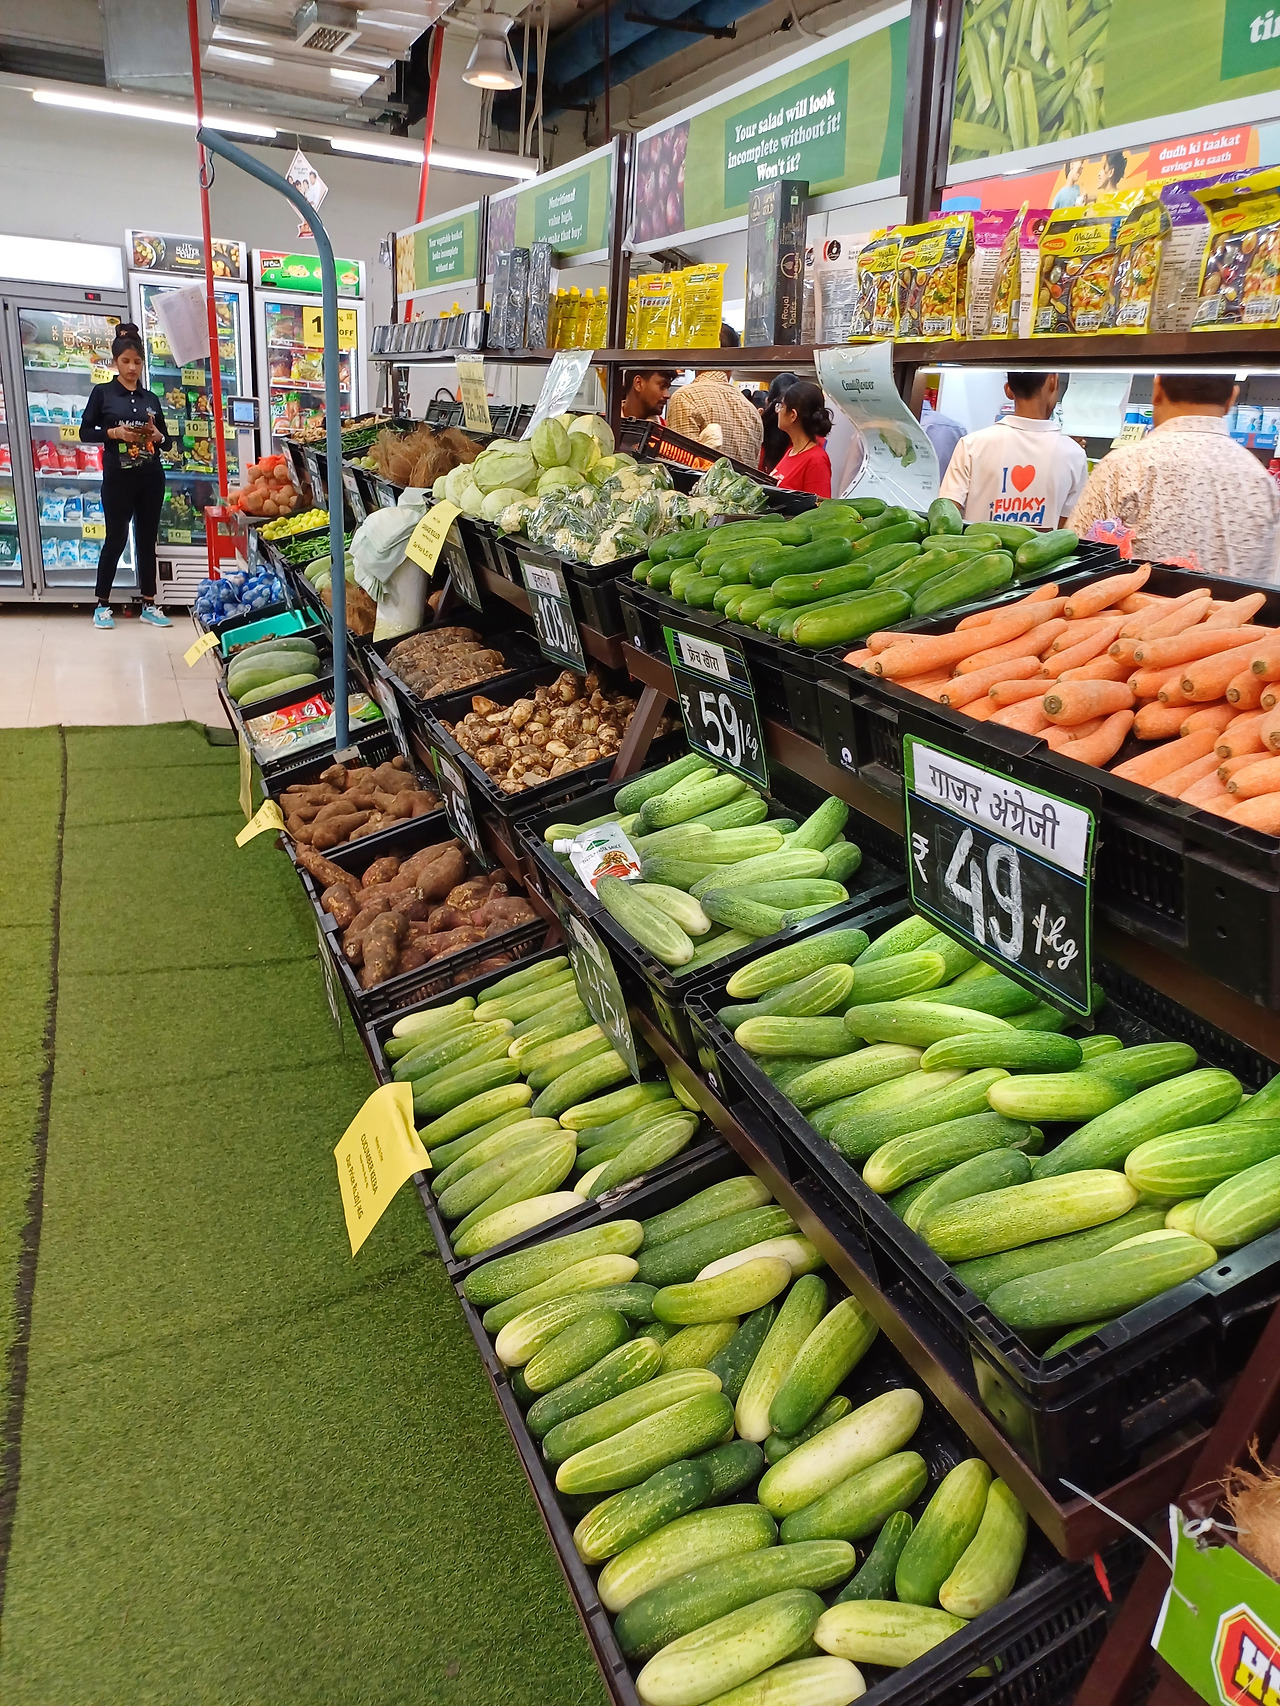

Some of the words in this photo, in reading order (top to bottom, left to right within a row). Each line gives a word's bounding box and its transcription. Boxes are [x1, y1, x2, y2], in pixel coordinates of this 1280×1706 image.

[1250, 9, 1280, 43] ti
[735, 123, 757, 143] Your
[758, 108, 784, 135] salad
[785, 97, 808, 123] will
[808, 87, 835, 114] look
[728, 138, 779, 169] incomplete
[780, 119, 826, 149] without
[826, 111, 841, 135] it!
[1159, 144, 1187, 161] dudh
[1188, 141, 1201, 155] ki
[1203, 133, 1241, 151] taakat
[756, 158, 785, 182] Won't
[786, 152, 801, 174] it?
[1161, 160, 1193, 174] savings
[1194, 157, 1205, 167] ke
[1206, 152, 1232, 165] saath
[548, 187, 576, 210] Nutritional
[548, 214, 560, 227] value
[560, 229, 571, 241] that
[571, 224, 583, 240] buy!
[782, 295, 790, 319] Royal
[62, 428, 75, 437] 79
[186, 423, 198, 432] 10
[1002, 467, 1009, 493] I
[929, 765, 982, 815] गाजर
[990, 788, 1060, 850] अंग्रेजी
